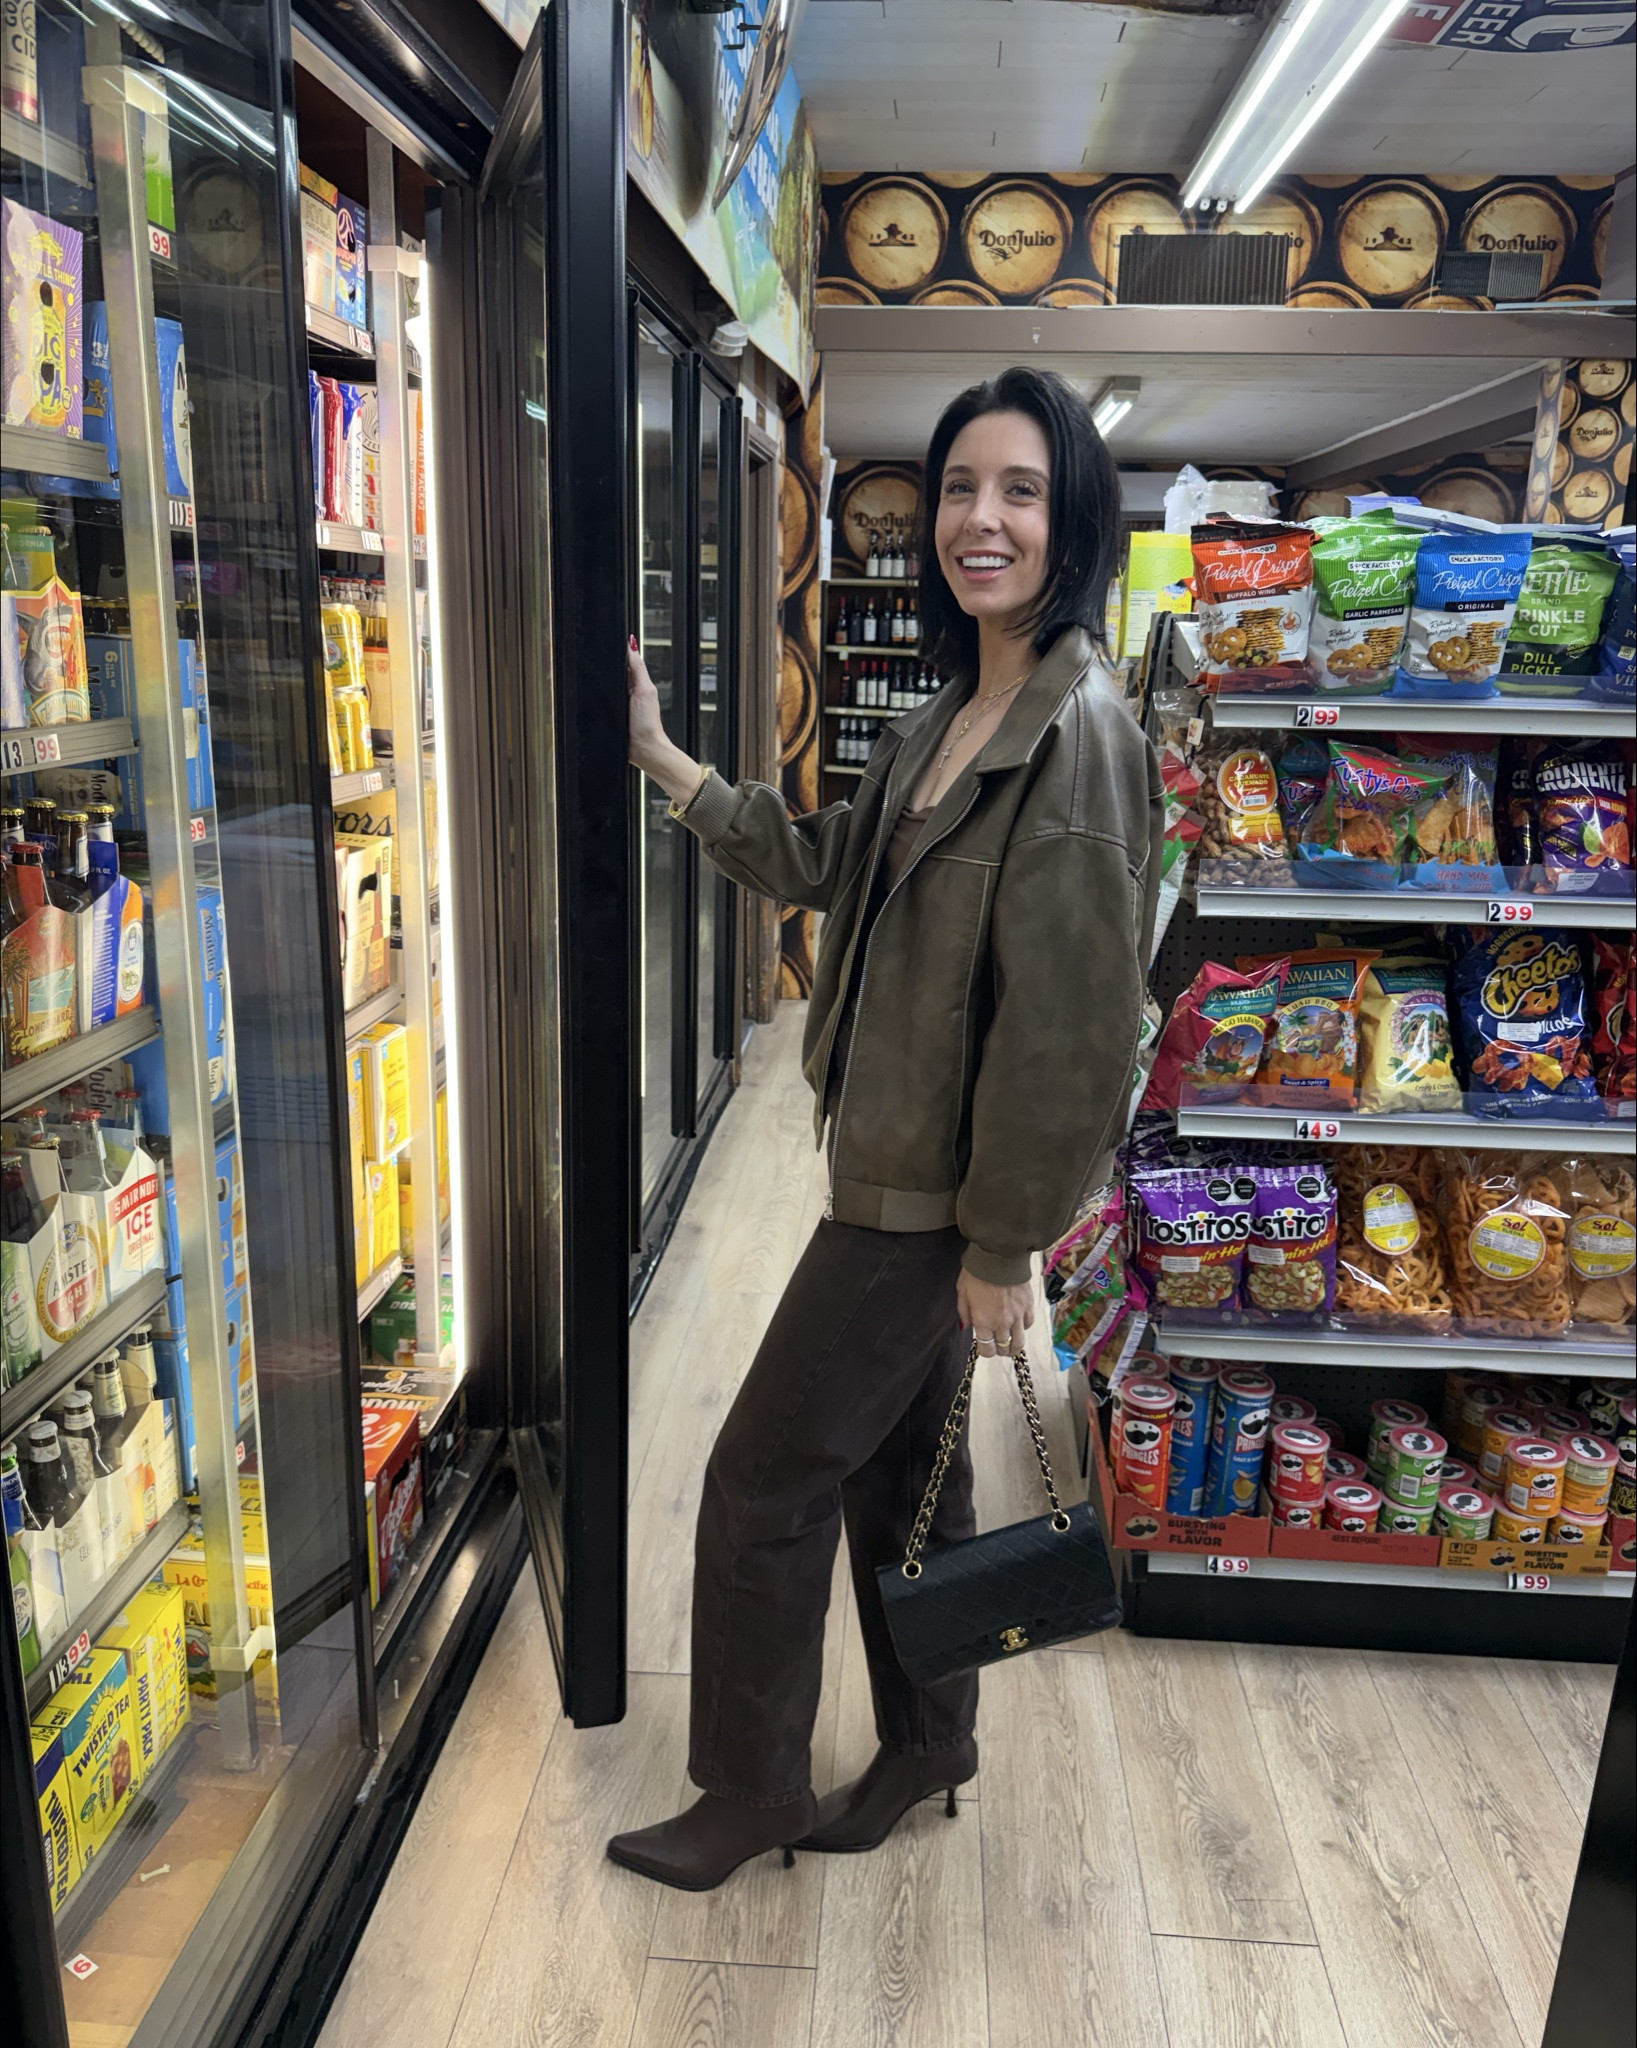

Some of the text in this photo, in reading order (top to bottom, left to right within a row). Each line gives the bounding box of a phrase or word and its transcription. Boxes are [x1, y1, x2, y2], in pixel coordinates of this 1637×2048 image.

[151, 231, 171, 257] 99
[1202, 555, 1301, 588] Pretzel Crisps
[1433, 567, 1522, 599] Pretzel Crisps
[1226, 588, 1277, 600] BUFFALO WING
[1328, 577, 1380, 607] Pretzel
[1345, 607, 1403, 619] GARLIC PARMESAN
[1519, 609, 1585, 623] RINKLE
[1528, 625, 1560, 637] CUT
[1510, 663, 1562, 677] PICKLE
[1523, 652, 1555, 665] DILL
[36, 738, 59, 761] 99
[334, 811, 395, 836] ors
[1483, 944, 1581, 1018] Cheetos
[1286, 998, 1333, 1012] LUAU BBQ
[114, 1183, 159, 1217] SMIRNOFF
[126, 1203, 153, 1237] ICE
[1147, 1212, 1250, 1244] TOSTITOS
[1502, 1217, 1529, 1231] Sol
[1593, 1219, 1619, 1231] Sol
[128, 1233, 155, 1256] ORIGINAL
[1121, 1441, 1159, 1466] PRINGLES
[1167, 1519, 1227, 1531] BURSTING
[1168, 1535, 1223, 1547] FLAVOR
[1524, 1550, 1568, 1559] BURSTING
[1524, 1561, 1565, 1571] FLAVOR
[176, 1573, 190, 1585] La
[172, 1622, 187, 1718] TWISTED TEA
[137, 1673, 153, 1761] PARTY PACK
[73, 1694, 130, 1778] TWISTED TEA
[45, 1789, 70, 1906] TWISTED TEA
[44, 1836, 54, 1884] ORIGINAL
